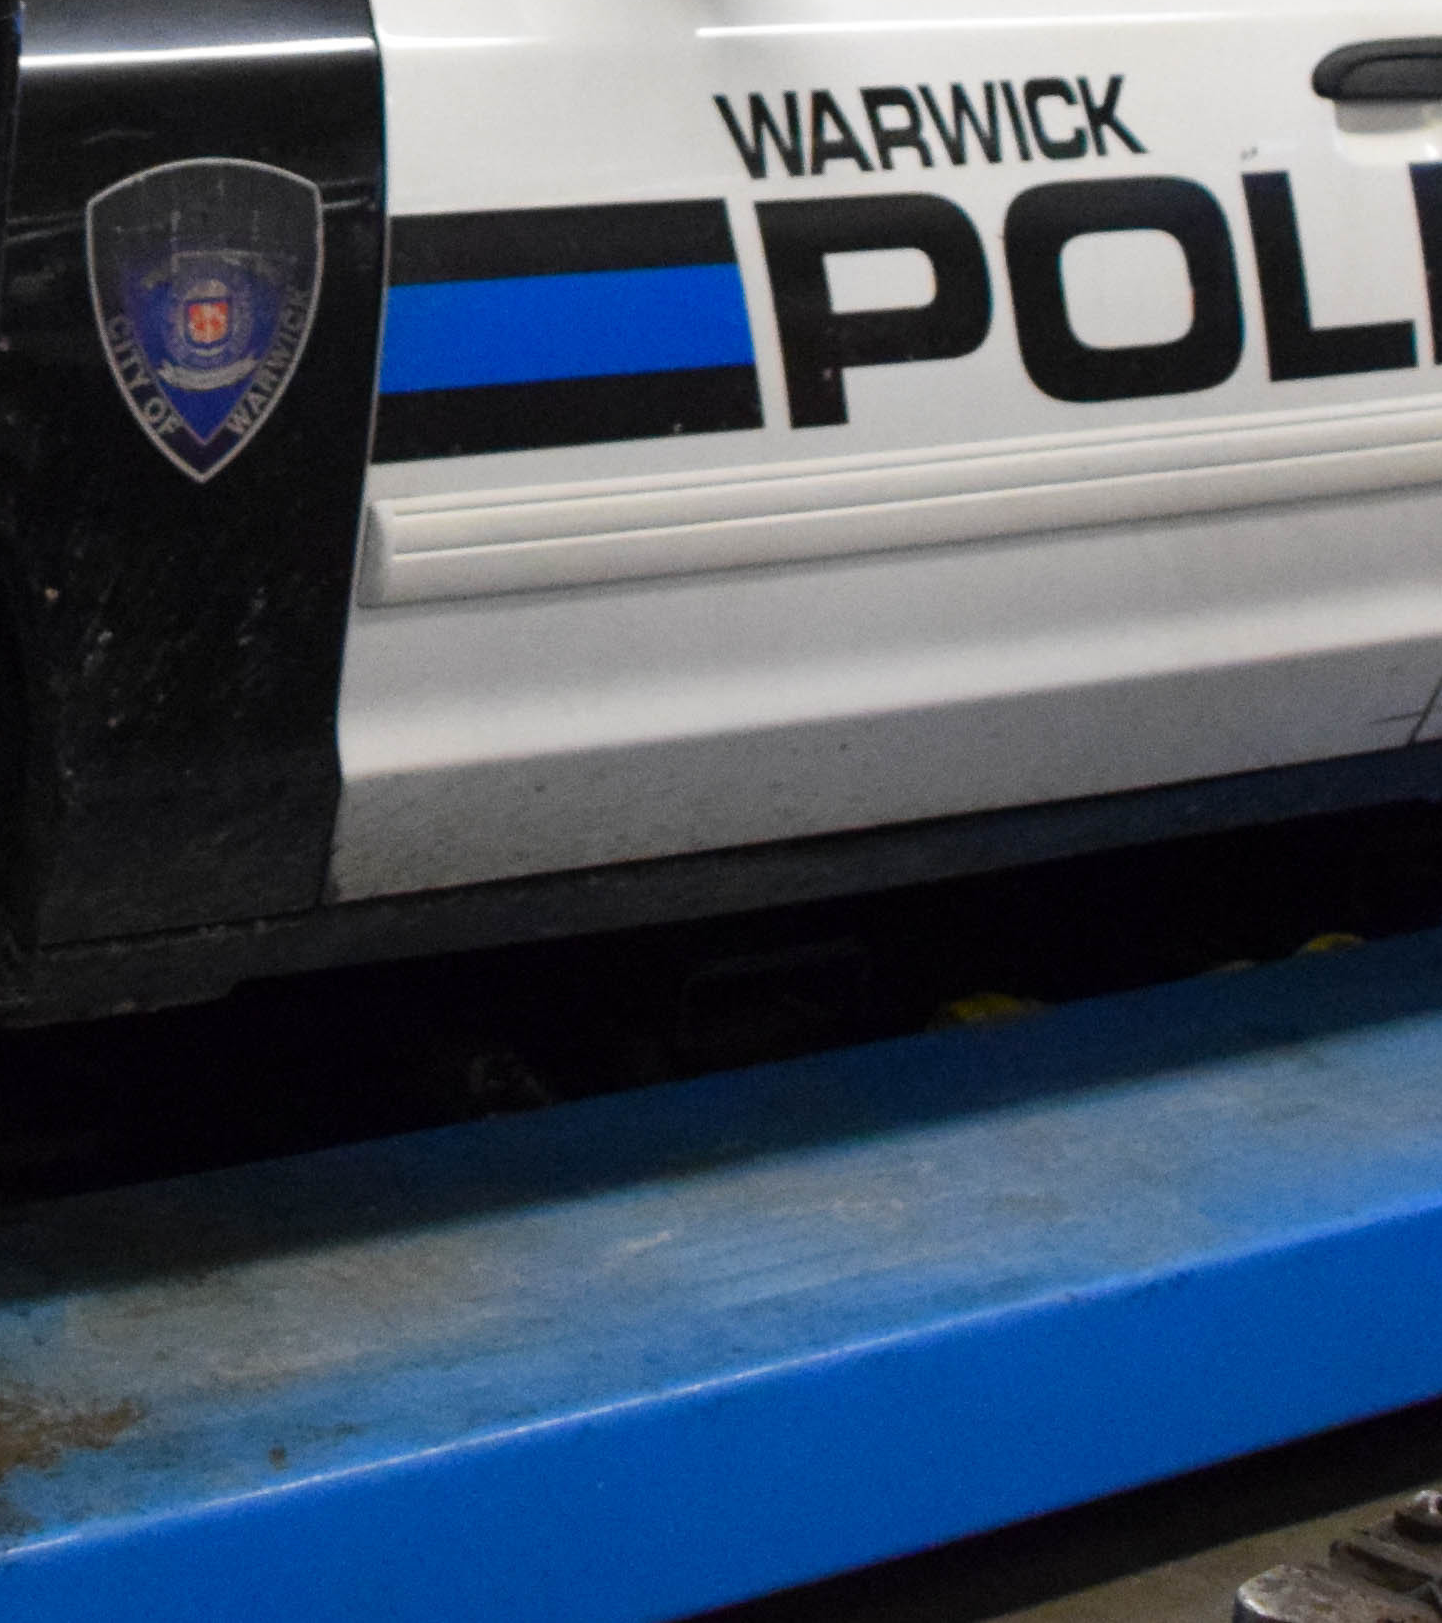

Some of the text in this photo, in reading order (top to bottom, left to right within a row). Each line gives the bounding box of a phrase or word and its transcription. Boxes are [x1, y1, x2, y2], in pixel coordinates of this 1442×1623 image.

[714, 77, 1146, 179] WARWICK
[106, 316, 183, 437] CITY OF
[225, 288, 312, 436] WARWICK
